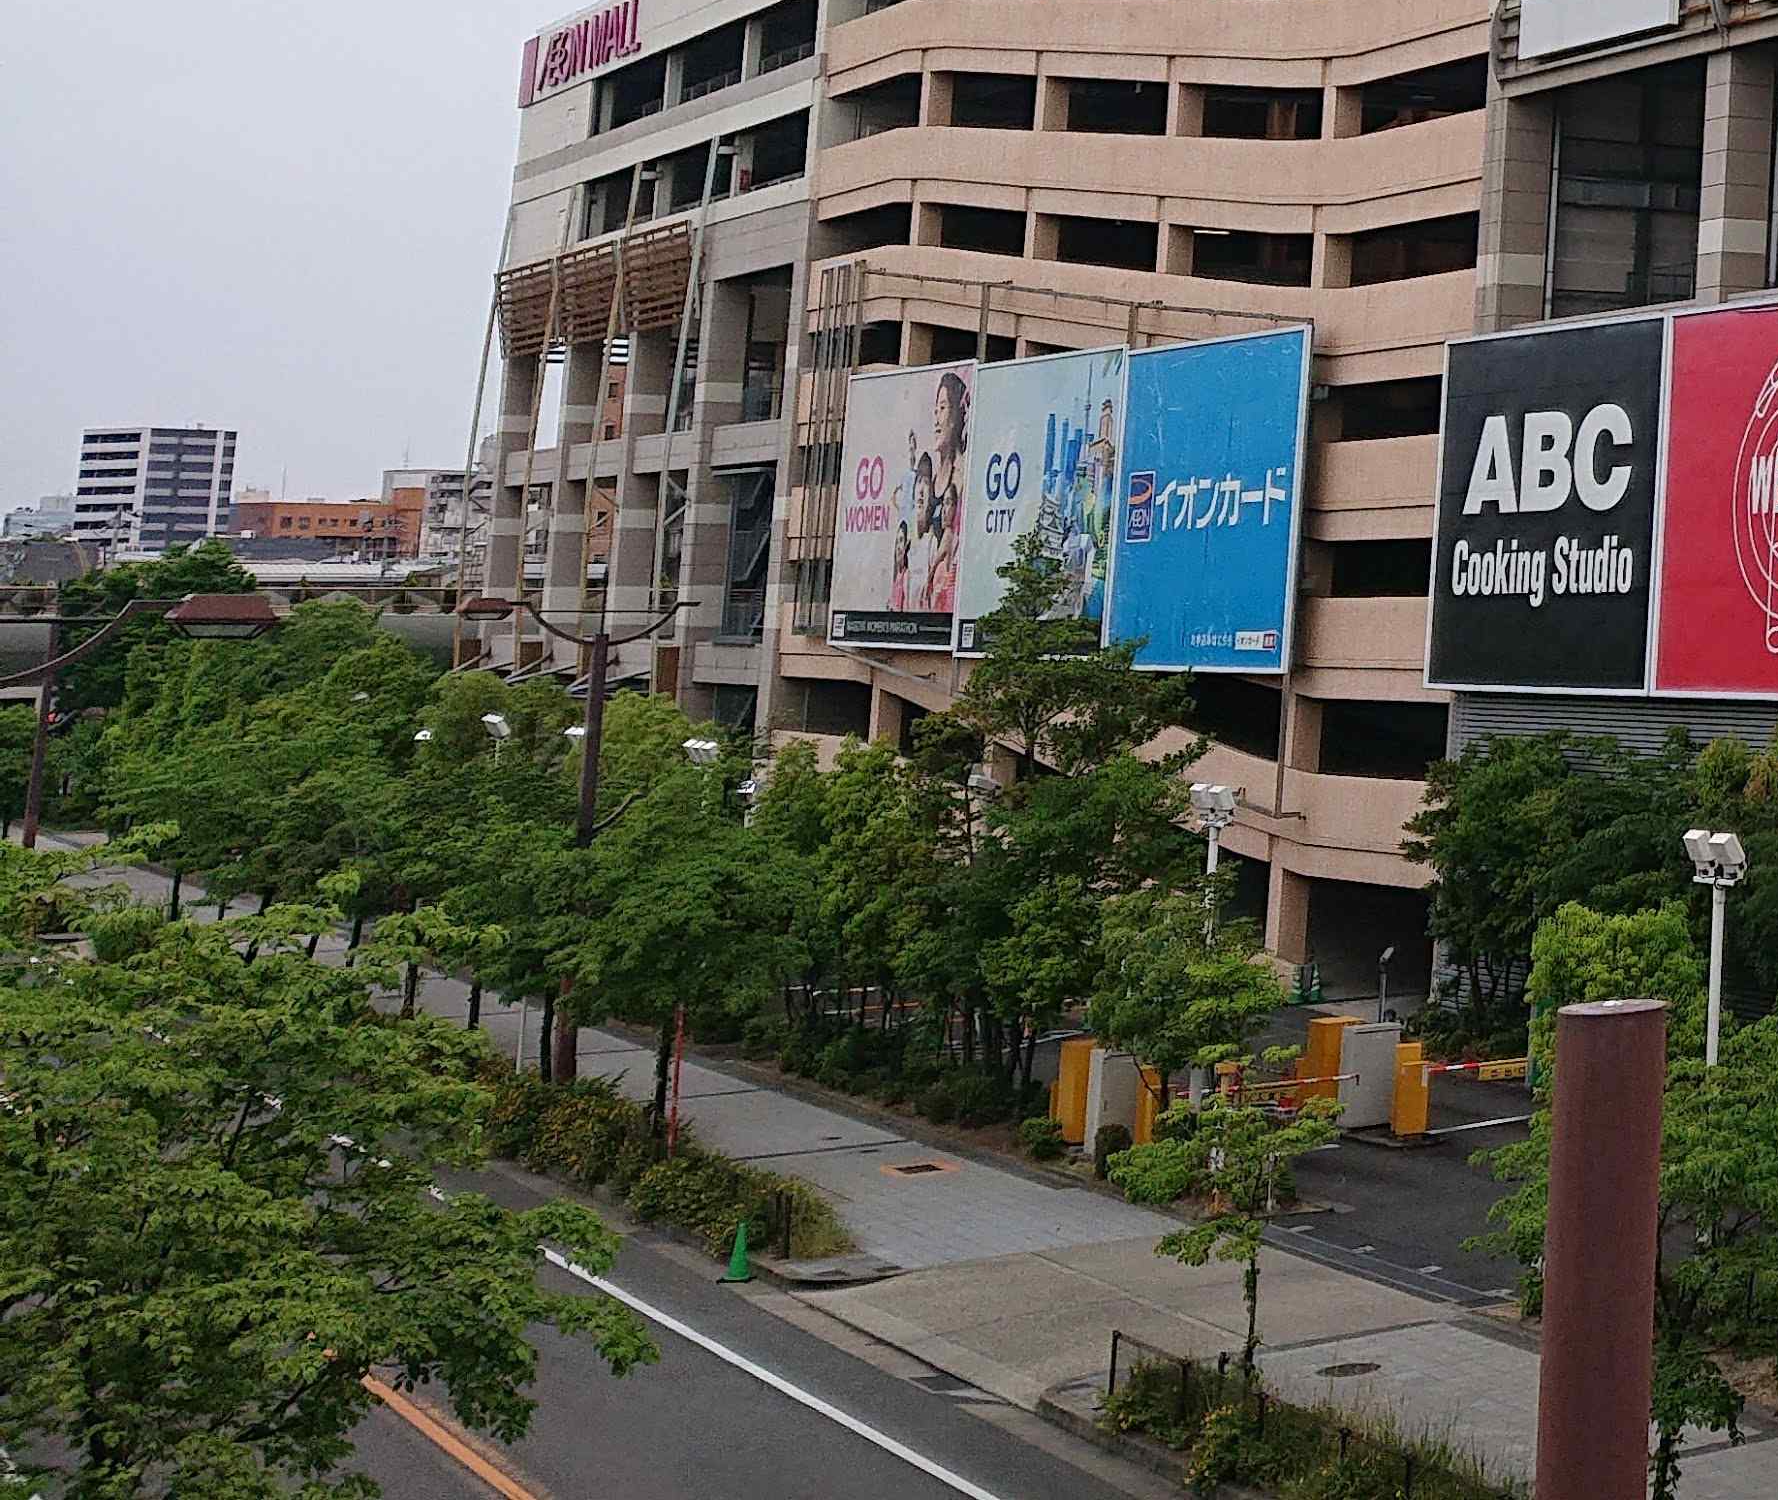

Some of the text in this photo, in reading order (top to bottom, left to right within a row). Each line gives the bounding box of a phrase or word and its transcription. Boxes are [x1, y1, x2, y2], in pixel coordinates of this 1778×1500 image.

[856, 455, 884, 500] GO
[986, 452, 1021, 500] GO
[1462, 403, 1633, 515] ABC
[845, 505, 890, 533] WOMEN
[986, 507, 1016, 534] CITY
[1155, 466, 1287, 532] イオンカード
[1452, 535, 1634, 607] Cooking Studio
